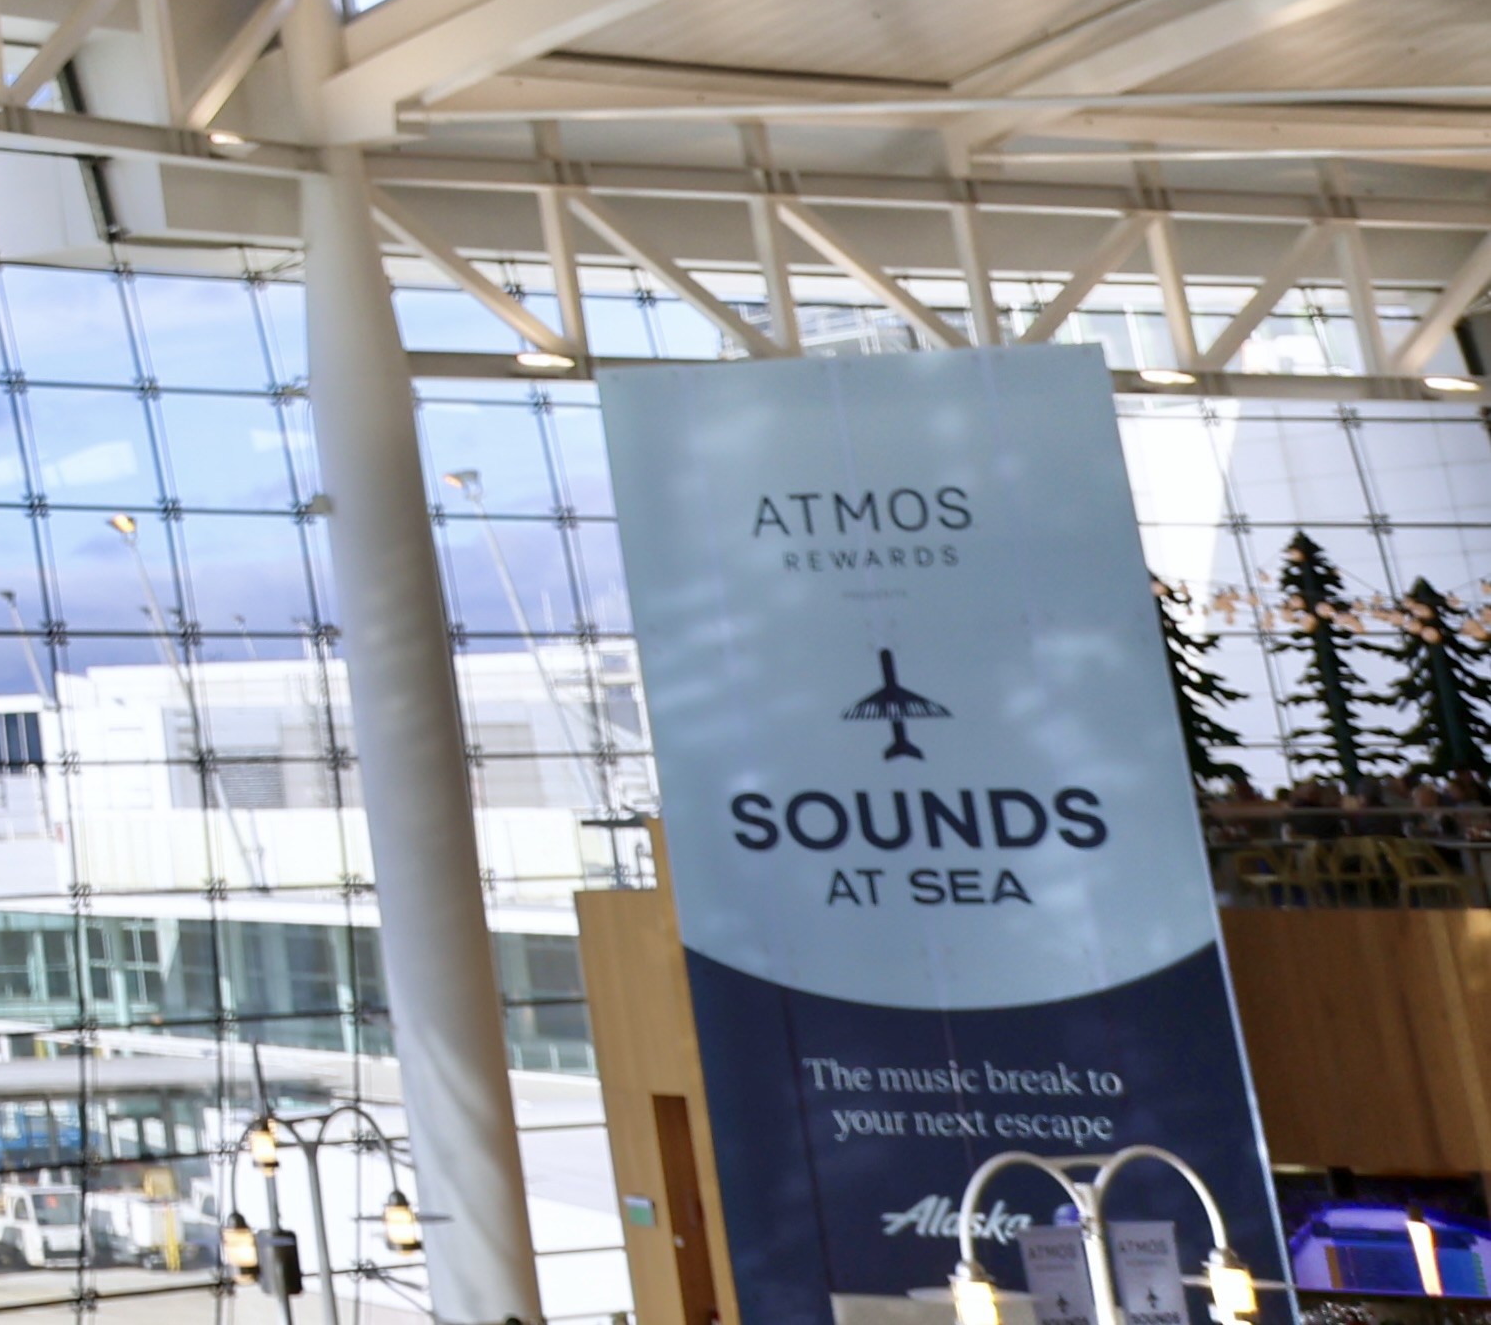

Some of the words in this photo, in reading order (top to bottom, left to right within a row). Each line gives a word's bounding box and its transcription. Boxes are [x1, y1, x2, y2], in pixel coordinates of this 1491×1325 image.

[752, 486, 973, 537] ATMOS
[783, 545, 960, 572] REWARDS
[730, 787, 1109, 851] SOUNDS
[827, 868, 885, 907] AT
[908, 868, 1035, 905] SEA
[802, 1057, 872, 1092] The
[877, 1059, 980, 1094] music
[983, 1060, 1083, 1096] break
[1086, 1068, 1124, 1097] to
[832, 1109, 909, 1142] your
[914, 1110, 990, 1138] next
[994, 1112, 1116, 1147] escape
